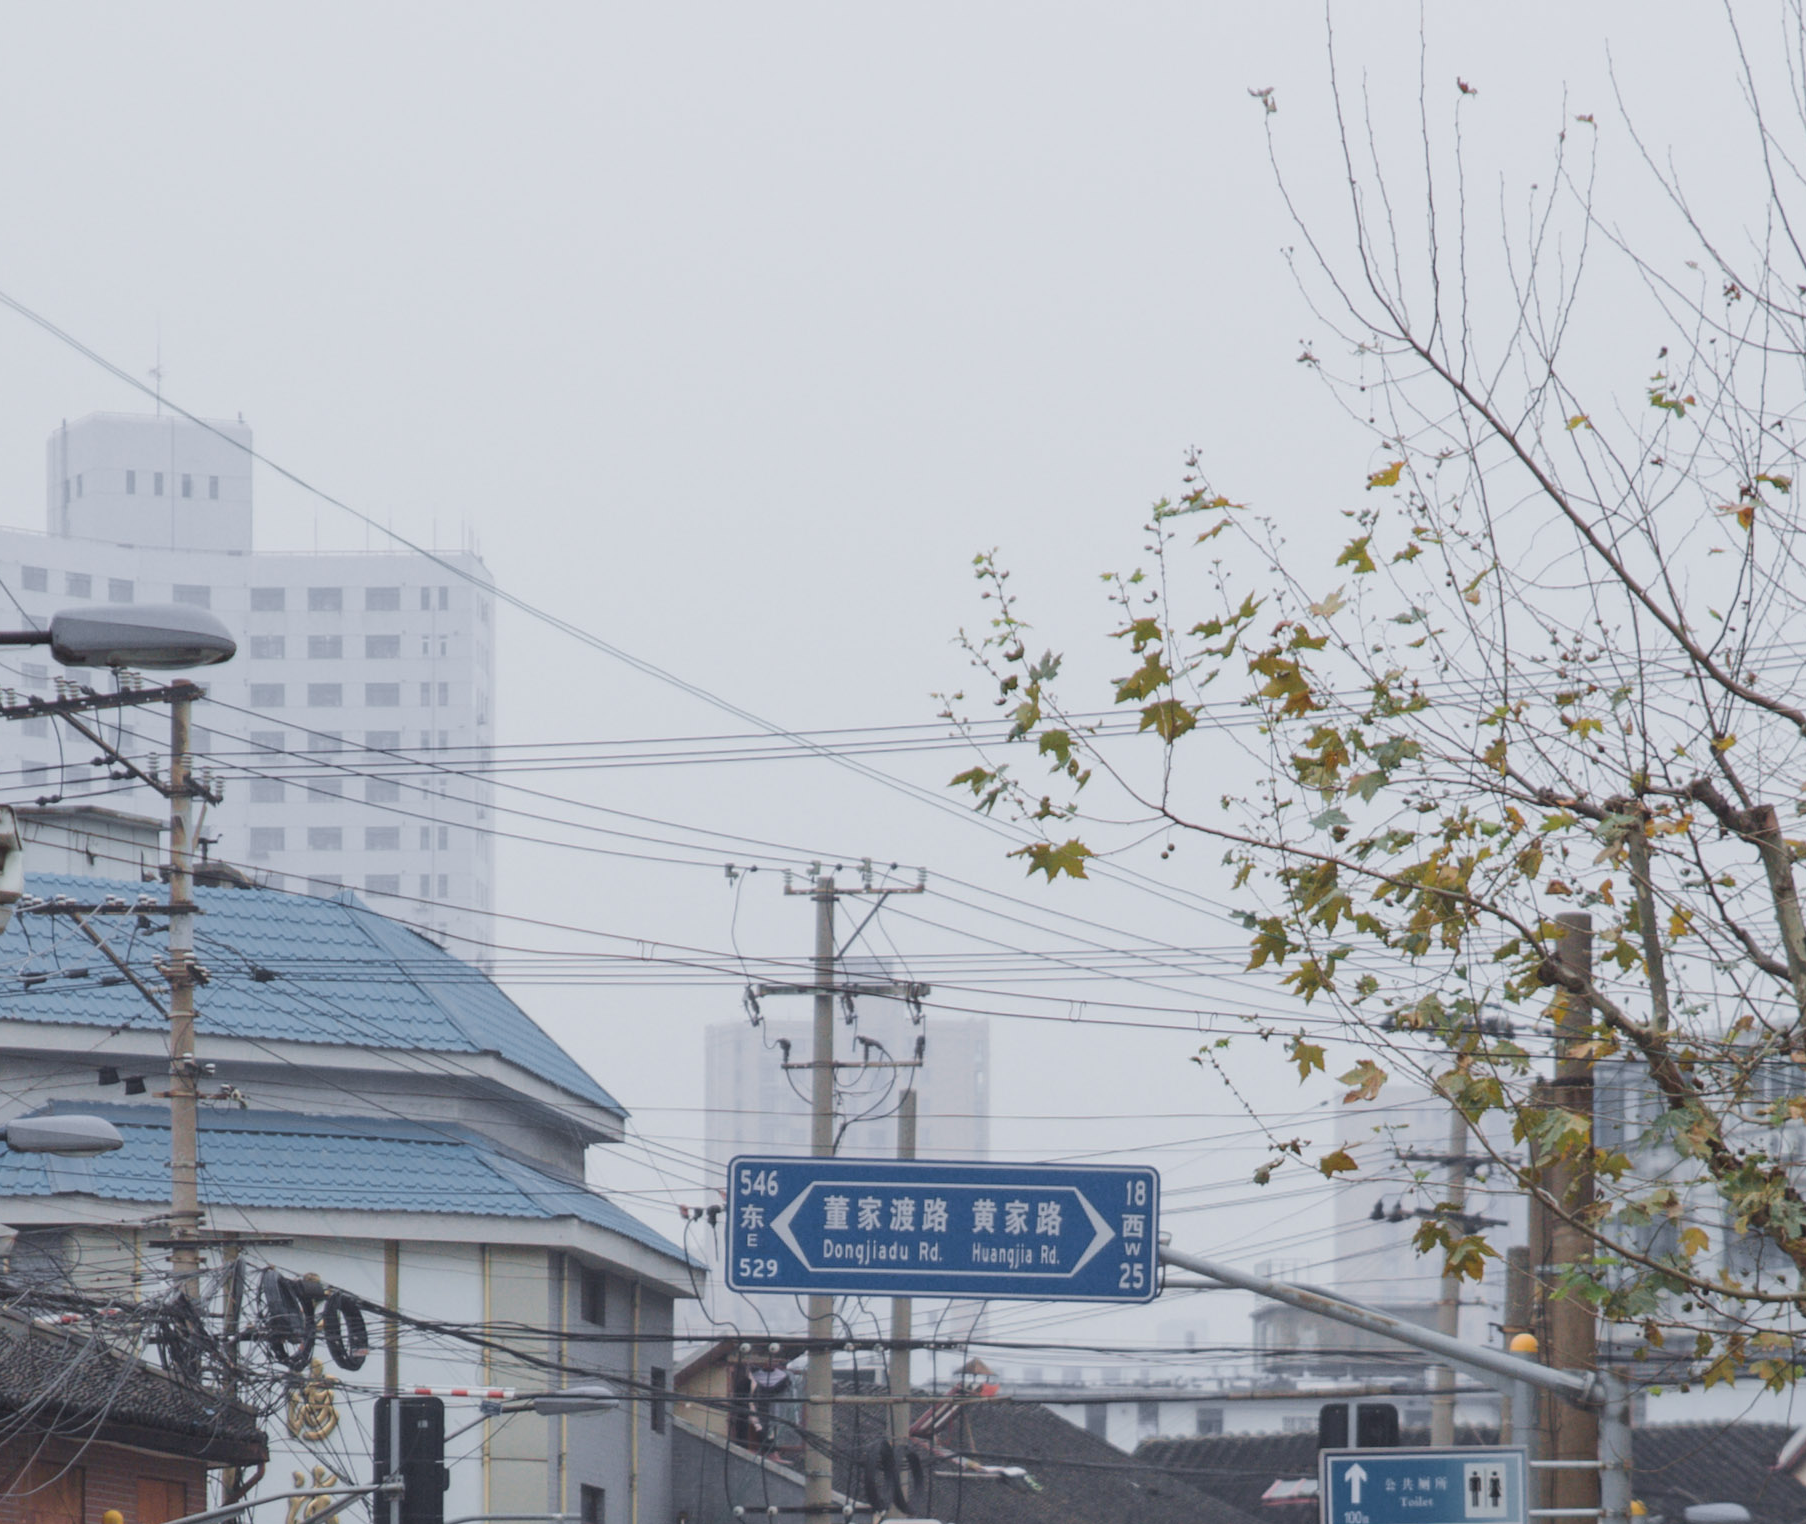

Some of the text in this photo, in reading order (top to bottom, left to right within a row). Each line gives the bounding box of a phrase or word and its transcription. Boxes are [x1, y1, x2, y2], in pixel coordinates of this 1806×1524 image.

[740, 1169, 779, 1197] 546
[1125, 1179, 1147, 1207] 18
[740, 1203, 765, 1231] 东
[823, 1194, 1063, 1237] 董家渡路 黄家路
[1121, 1213, 1146, 1239] 西
[746, 1233, 759, 1247] E
[822, 1238, 1061, 1269] Dongjiadu Rd. Huangjia Rd.
[1124, 1241, 1142, 1256] W
[739, 1257, 779, 1279] 529
[1118, 1262, 1144, 1290] 25
[1384, 1476, 1448, 1492] 公共厕所
[1399, 1496, 1434, 1508] Toilet
